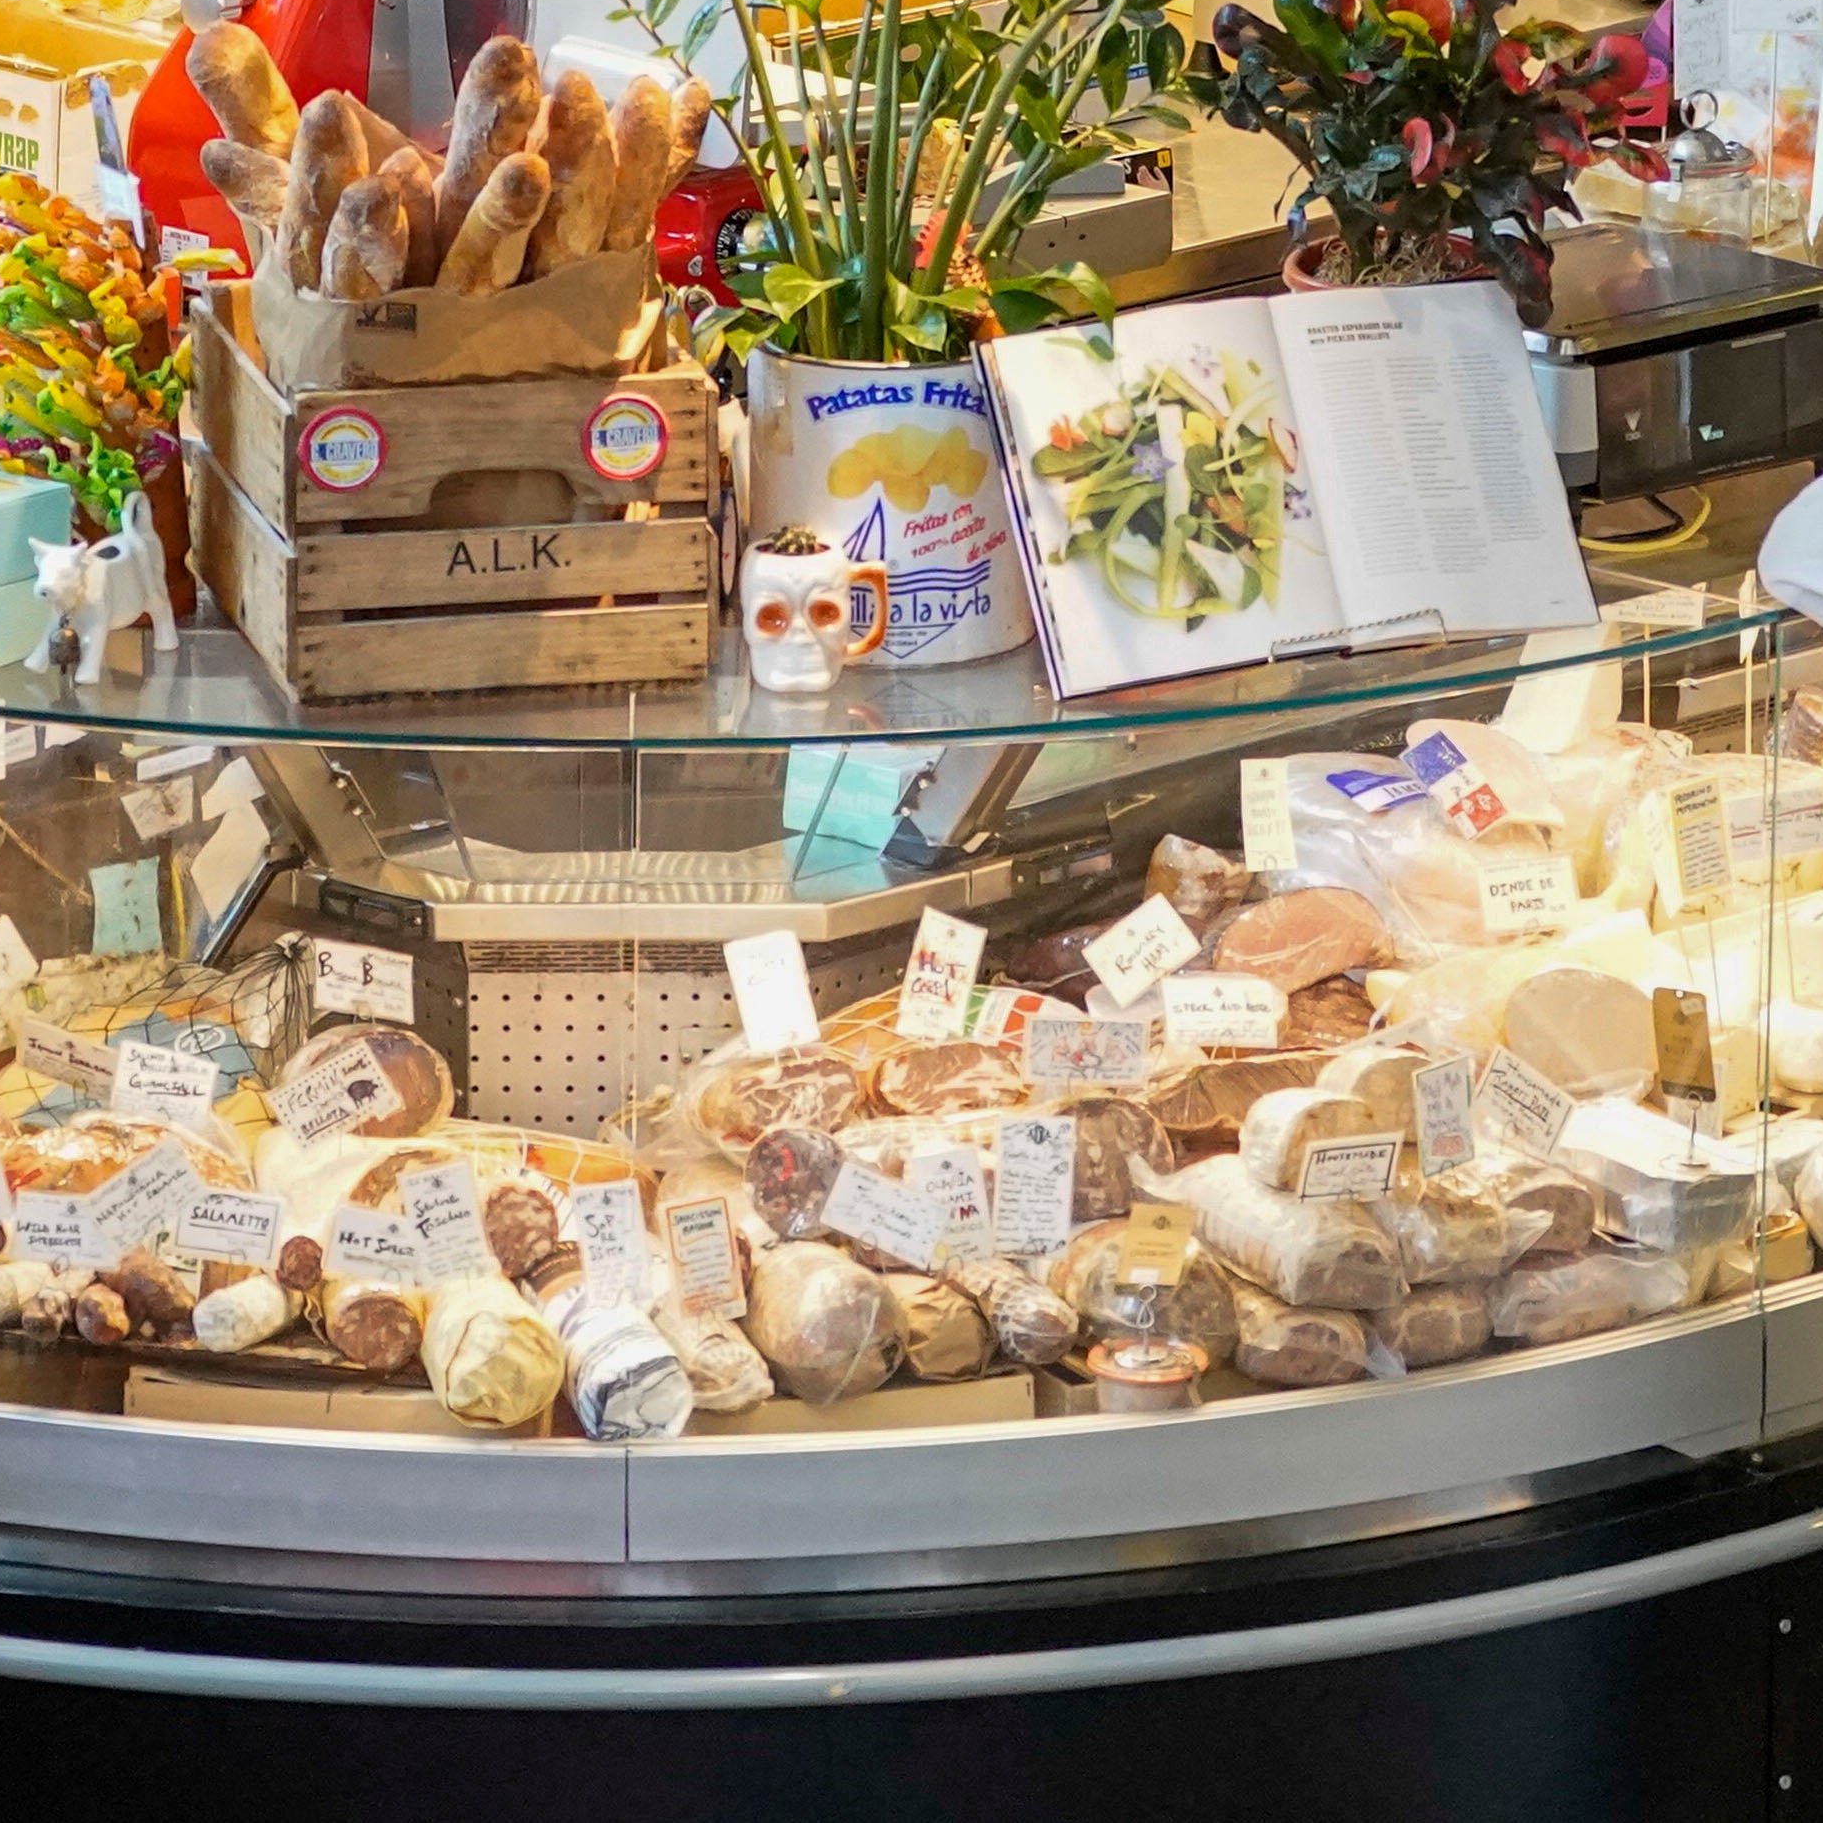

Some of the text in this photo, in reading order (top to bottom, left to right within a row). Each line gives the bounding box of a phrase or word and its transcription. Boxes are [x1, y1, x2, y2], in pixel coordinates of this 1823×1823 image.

[804, 380, 987, 423] Patatas Frita
[607, 424, 660, 447] CRAVERO
[326, 439, 378, 463] CRAVERO
[902, 502, 973, 539] Fritas con
[446, 532, 571, 577] A.L.K.
[910, 537, 950, 560] 100%
[889, 603, 903, 624] a
[912, 592, 932, 624] la
[939, 587, 992, 624] vista
[1489, 879, 1536, 898] DINDE
[1510, 897, 1546, 914] PARIS
[917, 949, 963, 978] HOT
[189, 1205, 270, 1230] SALAMETTO
